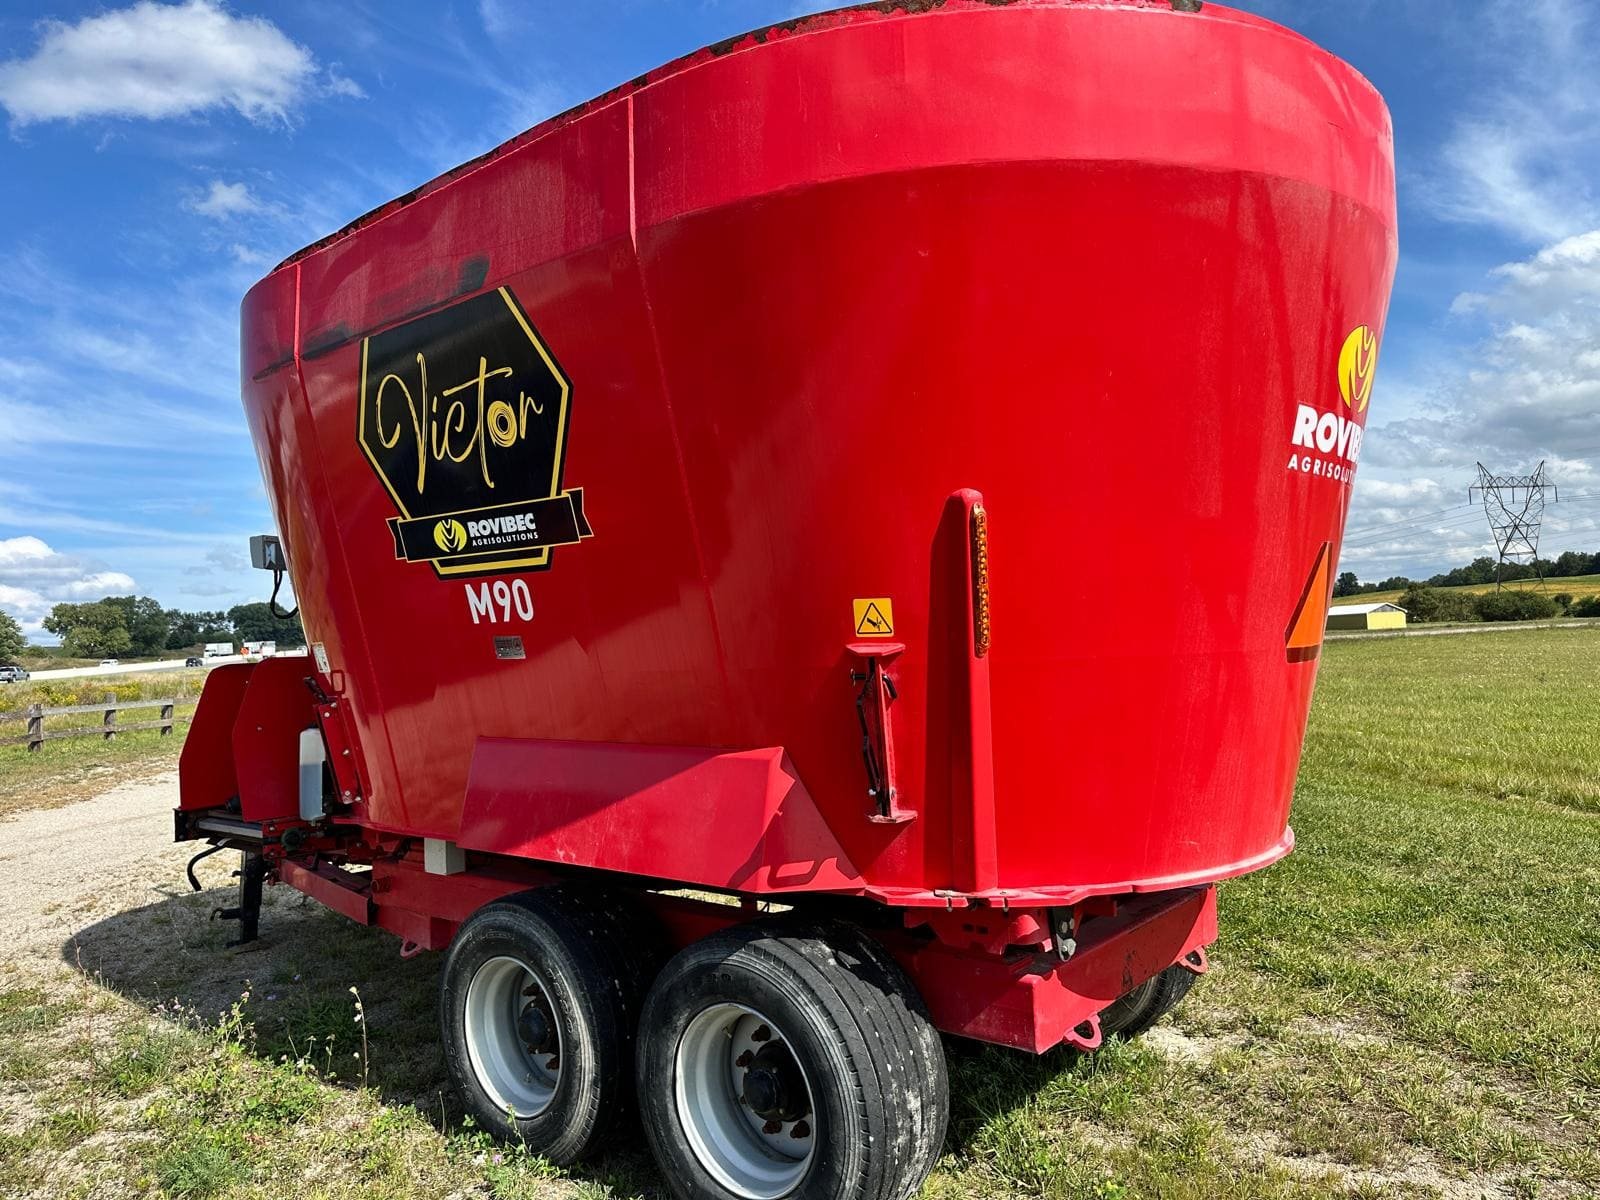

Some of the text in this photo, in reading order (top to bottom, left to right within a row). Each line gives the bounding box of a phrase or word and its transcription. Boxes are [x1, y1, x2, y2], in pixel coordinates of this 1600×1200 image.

[376, 353, 543, 494] Victor
[1292, 404, 1363, 464] ROVIB
[467, 513, 536, 537] ROVIBEC
[472, 532, 539, 547] AGRISOLUTIONS
[464, 579, 534, 624] M90
